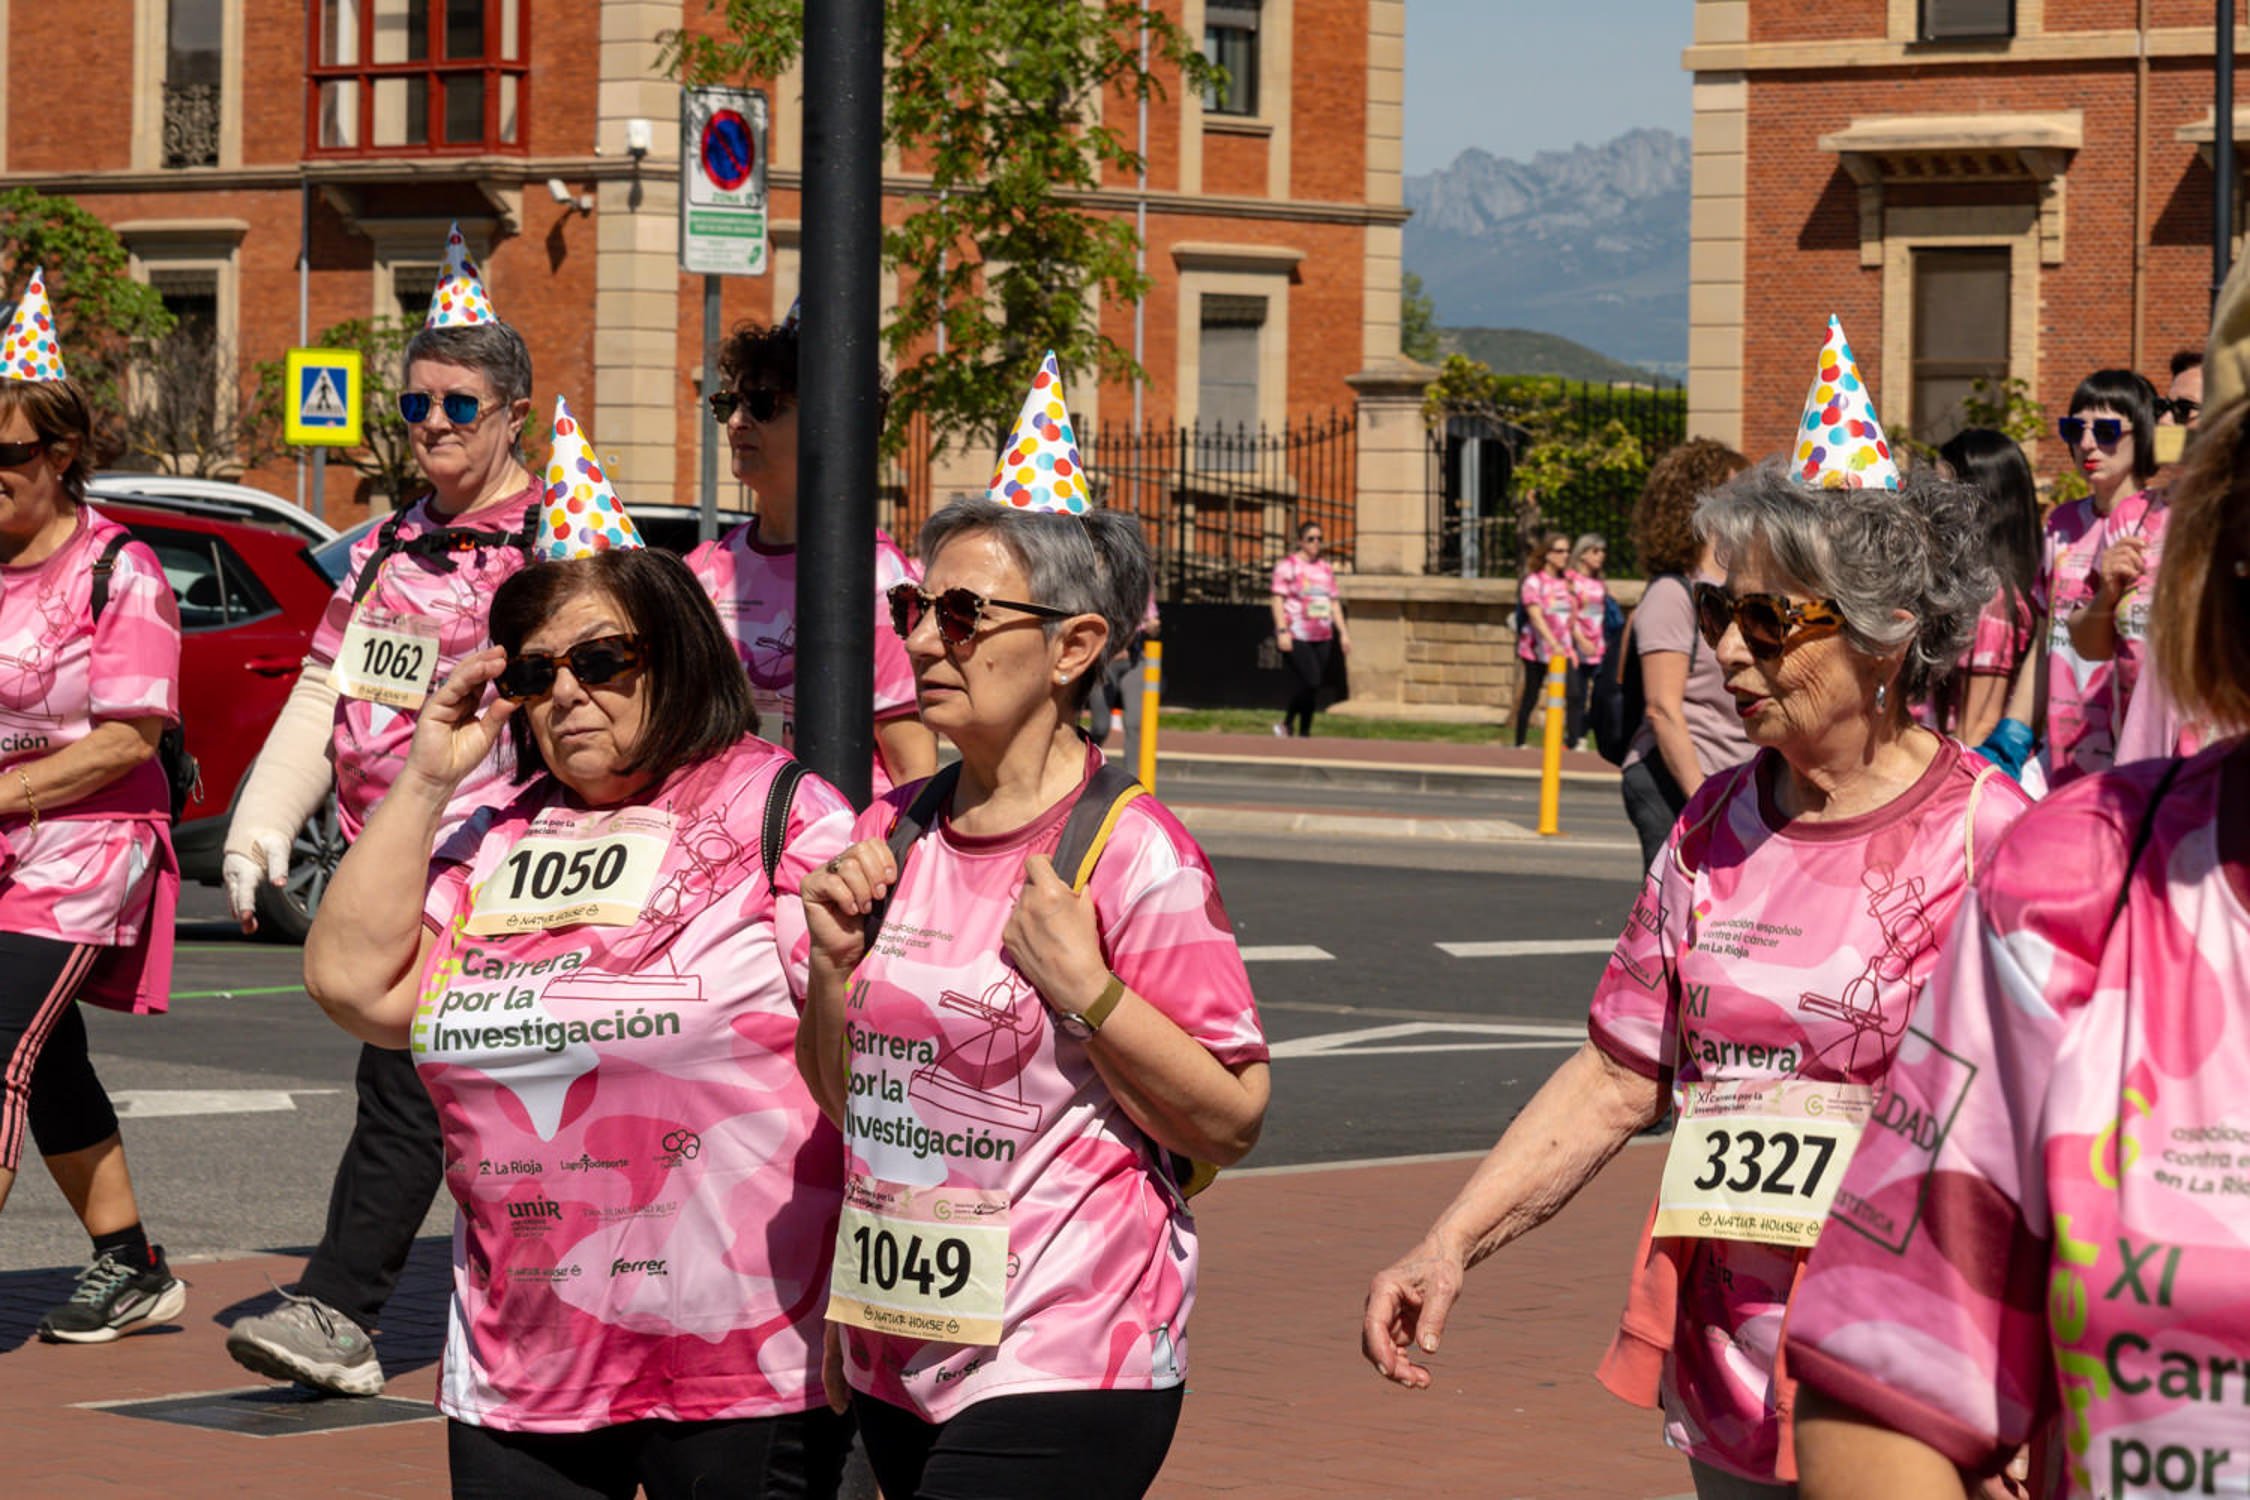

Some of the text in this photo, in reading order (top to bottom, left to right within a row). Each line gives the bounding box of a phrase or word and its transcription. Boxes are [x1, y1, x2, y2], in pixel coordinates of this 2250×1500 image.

[363, 637, 423, 681] 1062
[508, 843, 628, 899] 1050
[461, 947, 584, 981] Carrera
[438, 985, 535, 1019] por la
[847, 979, 871, 1009] XI
[1686, 982, 1710, 1018] XI
[433, 1008, 681, 1053] Investigación
[1687, 1029, 1797, 1074] Carrera
[881, 1068, 903, 1103] la
[495, 1160, 543, 1175] La Rioja
[1693, 1130, 1837, 1198] 3327
[2154, 1170, 2182, 1189] en
[2188, 1176, 2214, 1193] La
[1713, 1214, 1804, 1234] NATUR HOUSE
[853, 1225, 971, 1299] 1049
[2103, 1236, 2183, 1308] XI
[875, 1310, 906, 1325] NATUR
[909, 1315, 944, 1332] HOUSE
[2111, 1435, 2231, 1500] por
